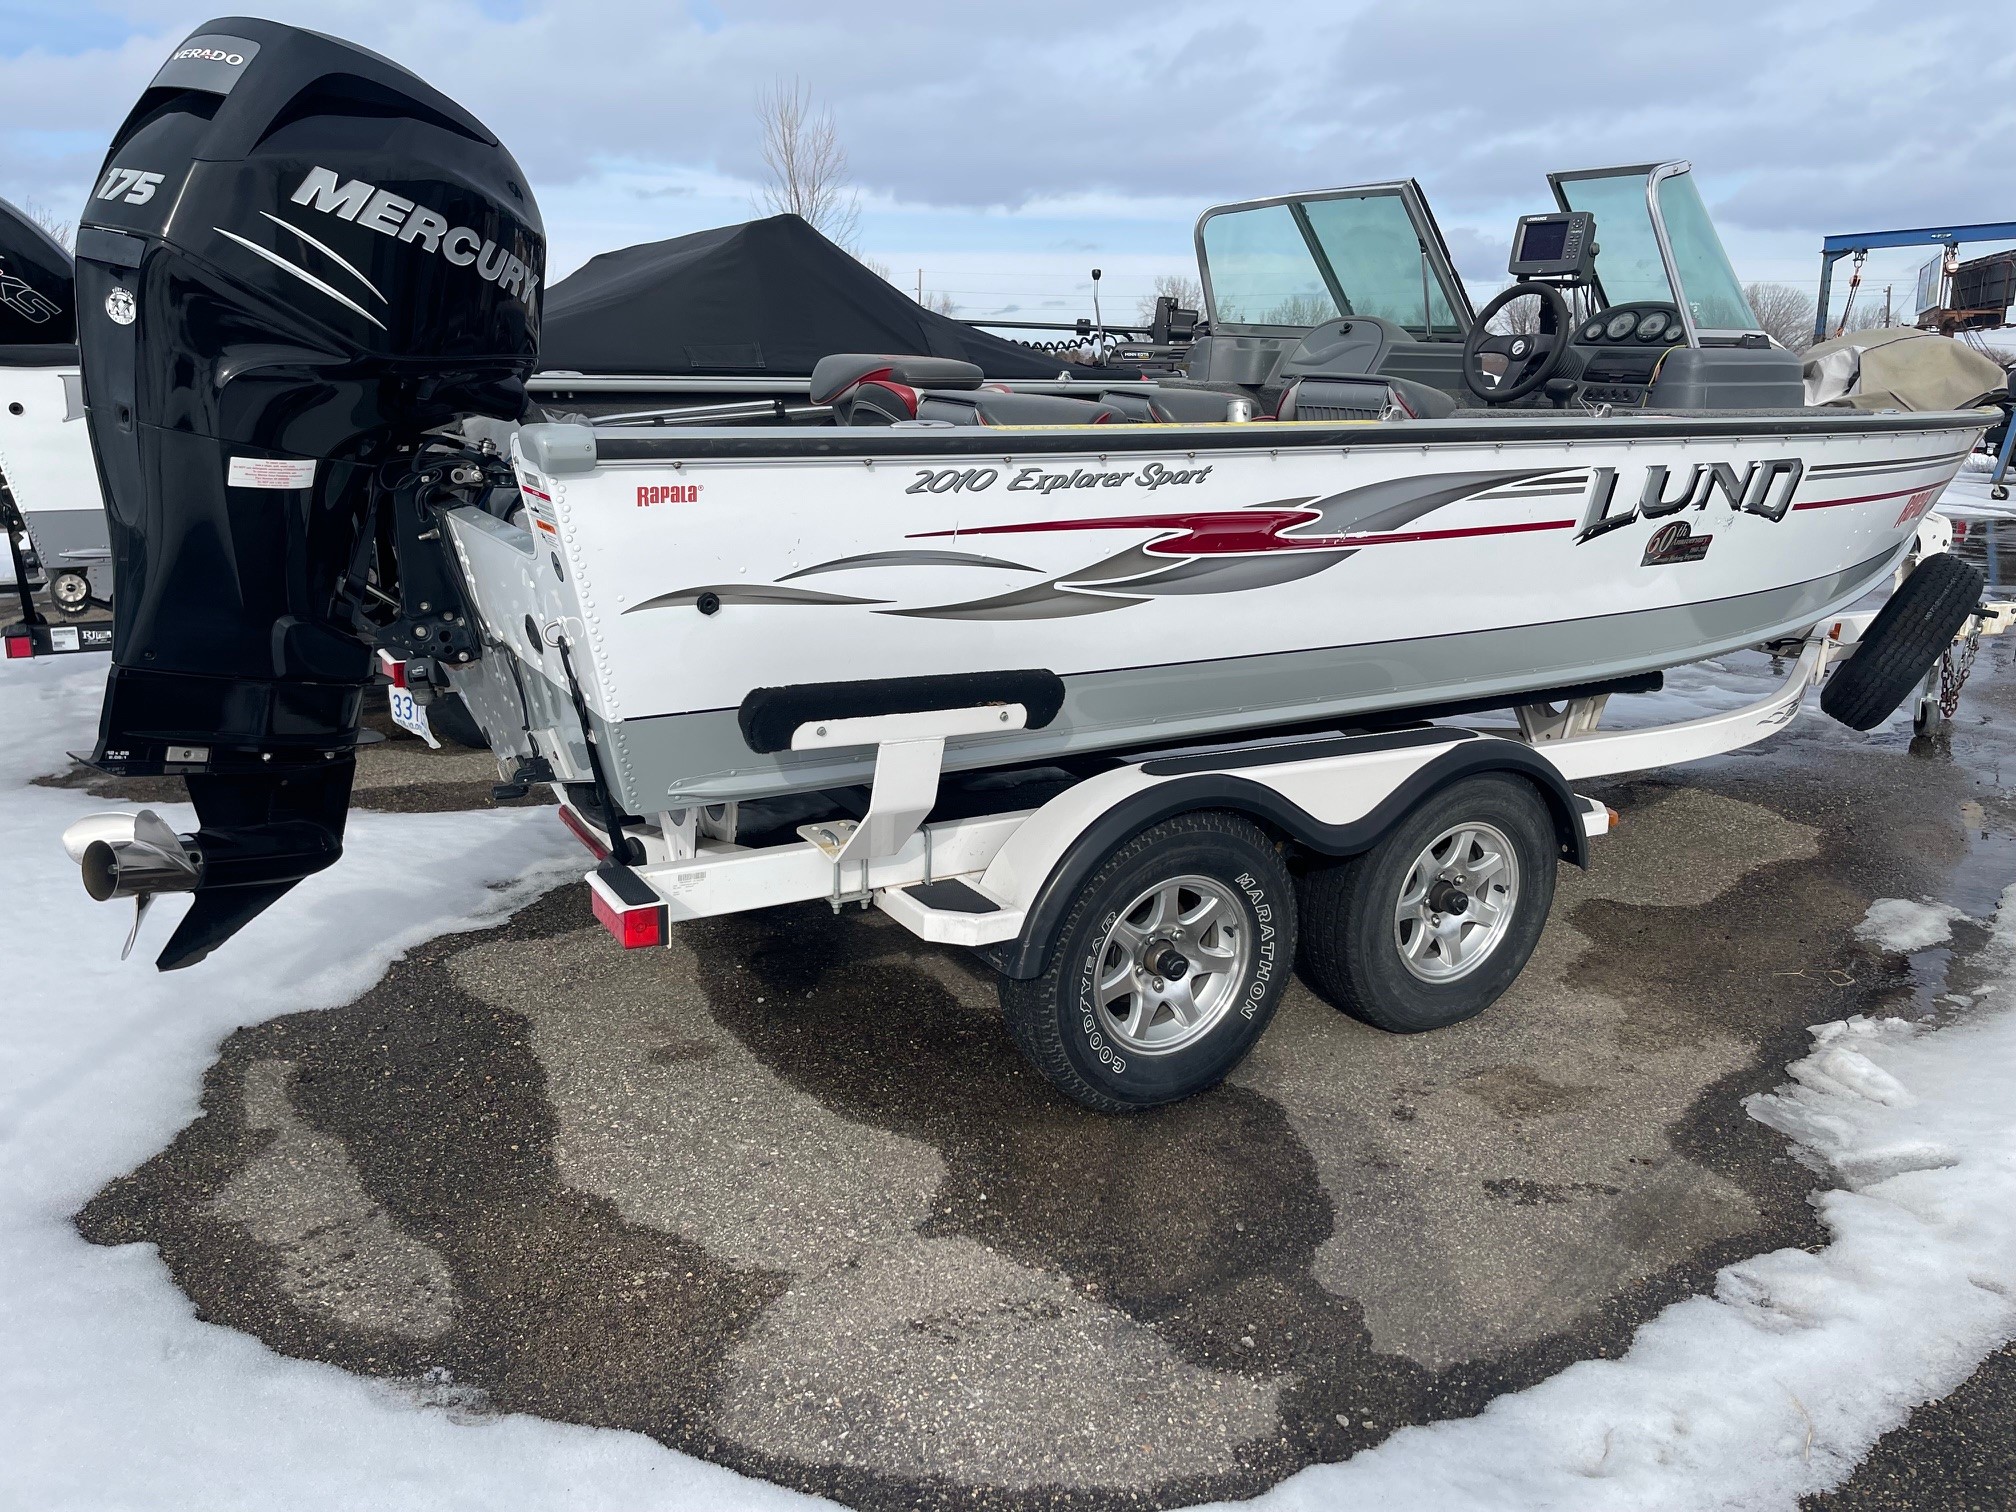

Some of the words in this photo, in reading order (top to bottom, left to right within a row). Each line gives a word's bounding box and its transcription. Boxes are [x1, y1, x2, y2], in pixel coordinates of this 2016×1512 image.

[173, 48, 244, 66] VERADO
[96, 167, 166, 206] 175
[290, 165, 540, 304] MERCURY
[905, 468, 999, 495] 2010
[1006, 468, 1135, 495] Explorer
[1134, 462, 1214, 491] Sport
[1572, 457, 1804, 547] LUND
[1647, 523, 1689, 553] 60th
[1234, 872, 1275, 1020] MARATHON
[1080, 911, 1126, 1074] GOODYEAR
